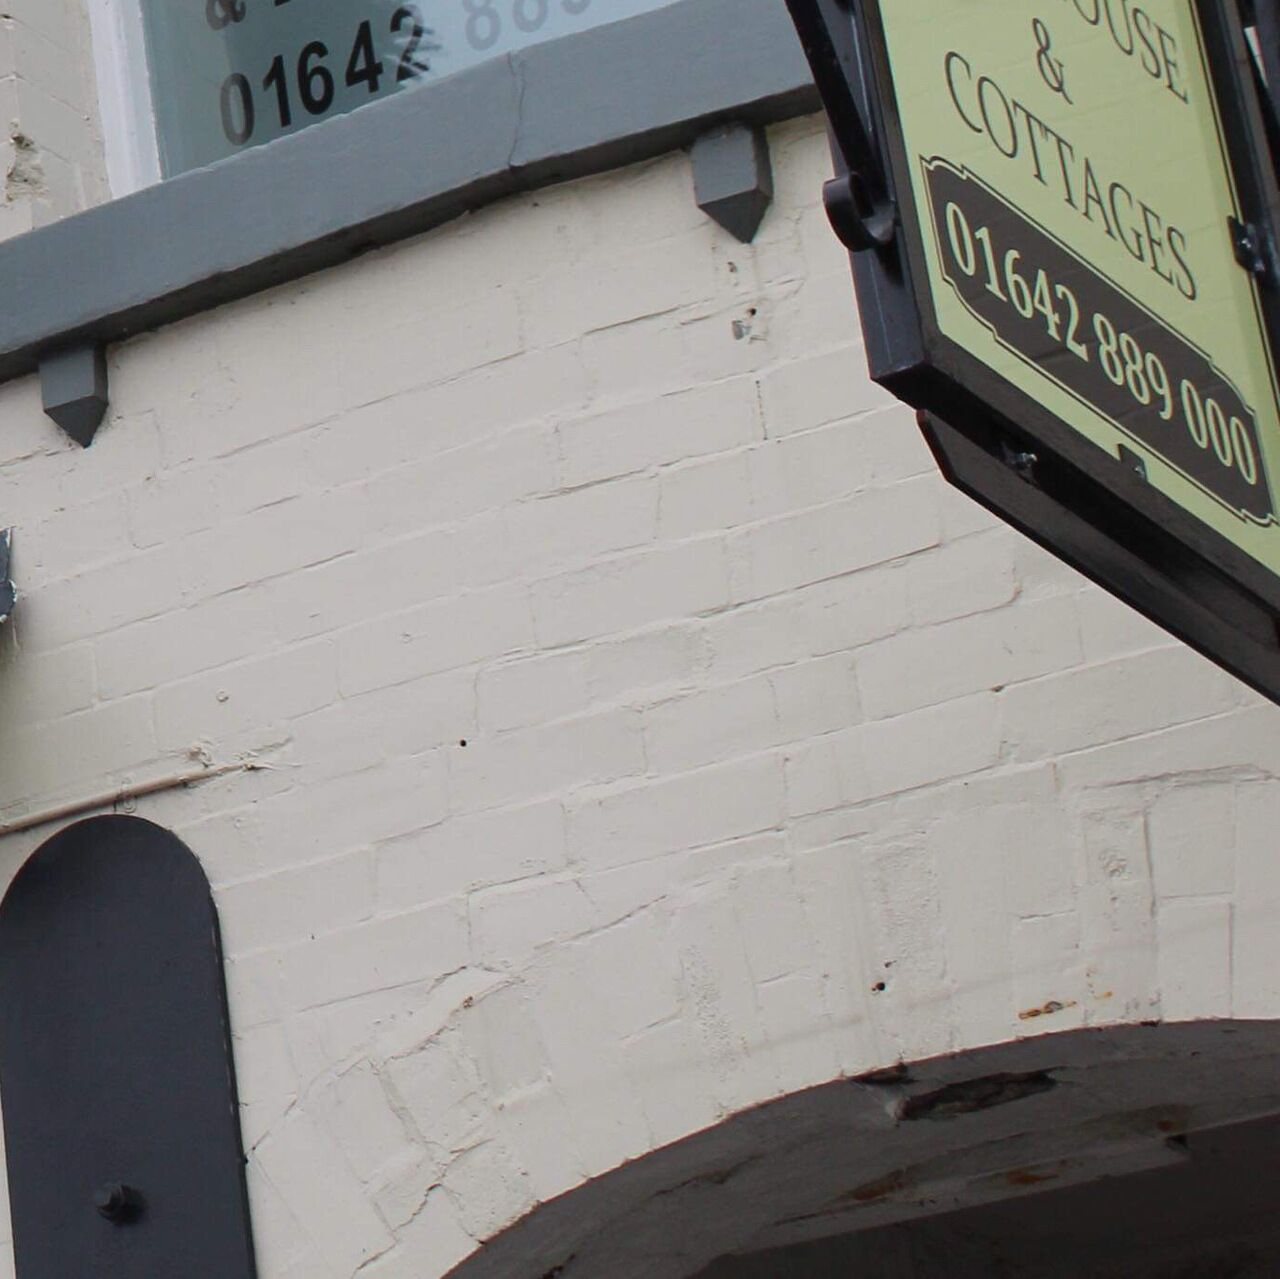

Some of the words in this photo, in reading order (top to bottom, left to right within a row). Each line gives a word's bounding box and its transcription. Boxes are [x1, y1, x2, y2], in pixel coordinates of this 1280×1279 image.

[219, 4, 429, 146] 01642
[1033, 18, 1073, 105] &
[945, 51, 1197, 301] COTTAGES
[945, 202, 1089, 362] 01642
[1093, 313, 1174, 421] 889
[1181, 379, 1257, 486] 000
